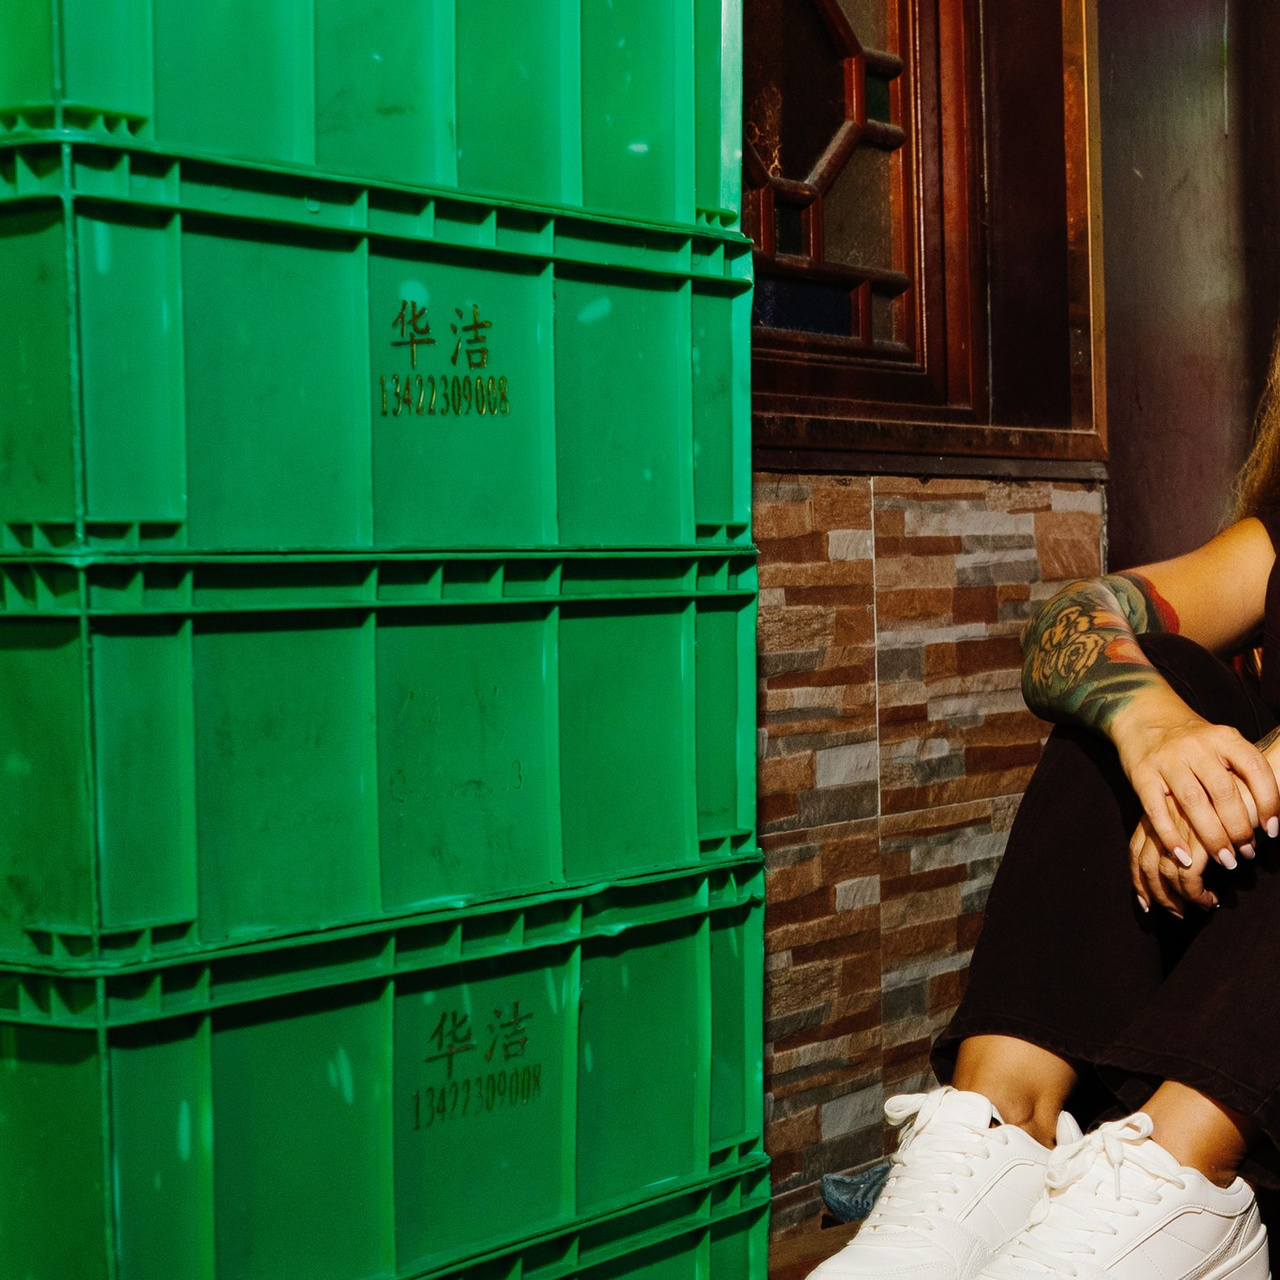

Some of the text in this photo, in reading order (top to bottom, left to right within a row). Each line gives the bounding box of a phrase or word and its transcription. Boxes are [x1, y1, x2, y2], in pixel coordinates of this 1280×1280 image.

[390, 299, 493, 371] 华洁
[379, 373, 511, 417] 13422309008
[423, 1000, 535, 1081] 华洁
